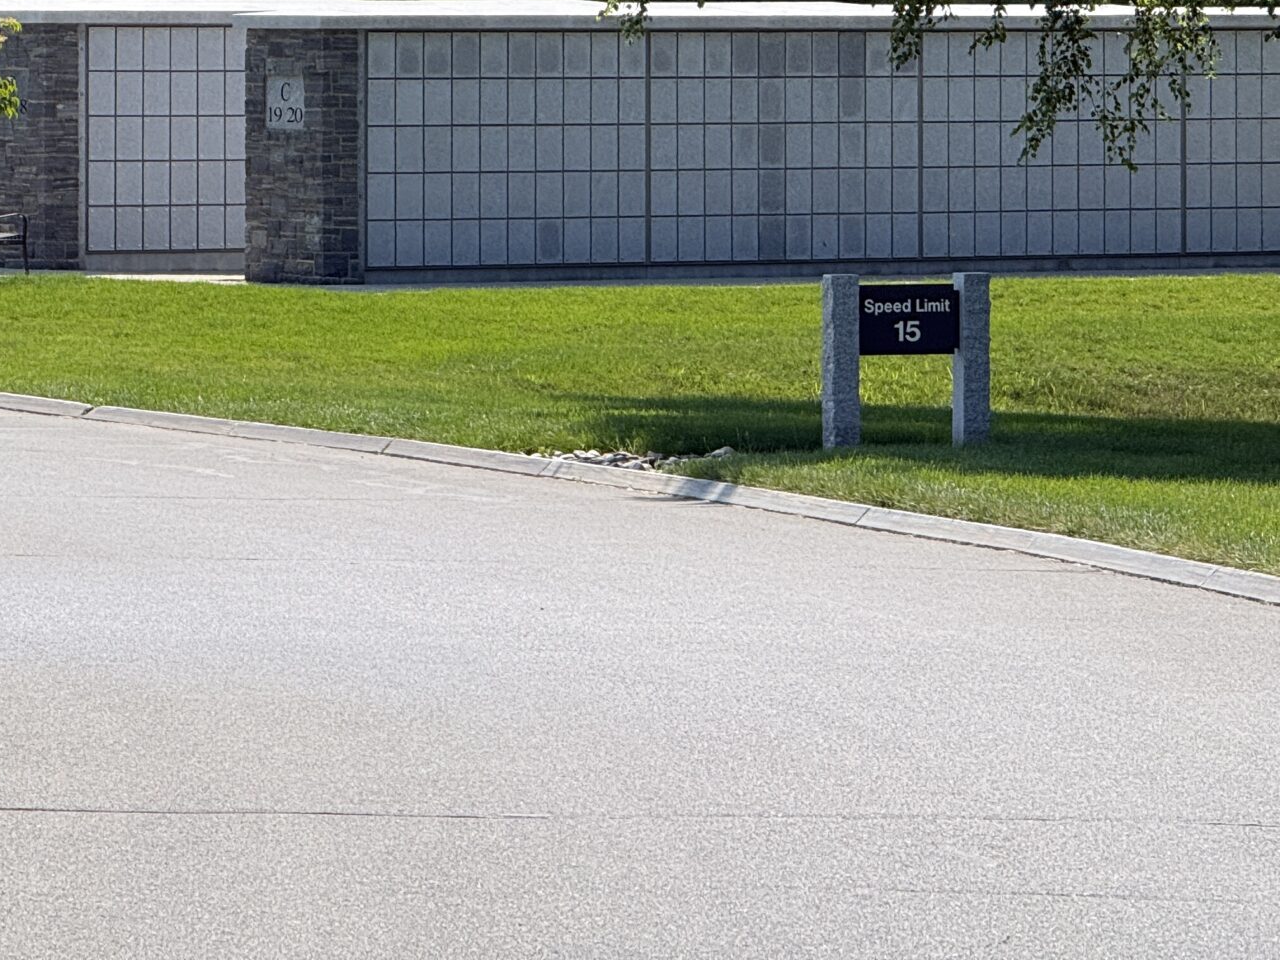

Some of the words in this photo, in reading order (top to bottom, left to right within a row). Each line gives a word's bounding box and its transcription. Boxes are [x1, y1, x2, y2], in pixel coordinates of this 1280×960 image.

[281, 82, 291, 101] C
[864, 298, 912, 316] Speed
[915, 298, 951, 313] Limit
[894, 320, 922, 343] 15
